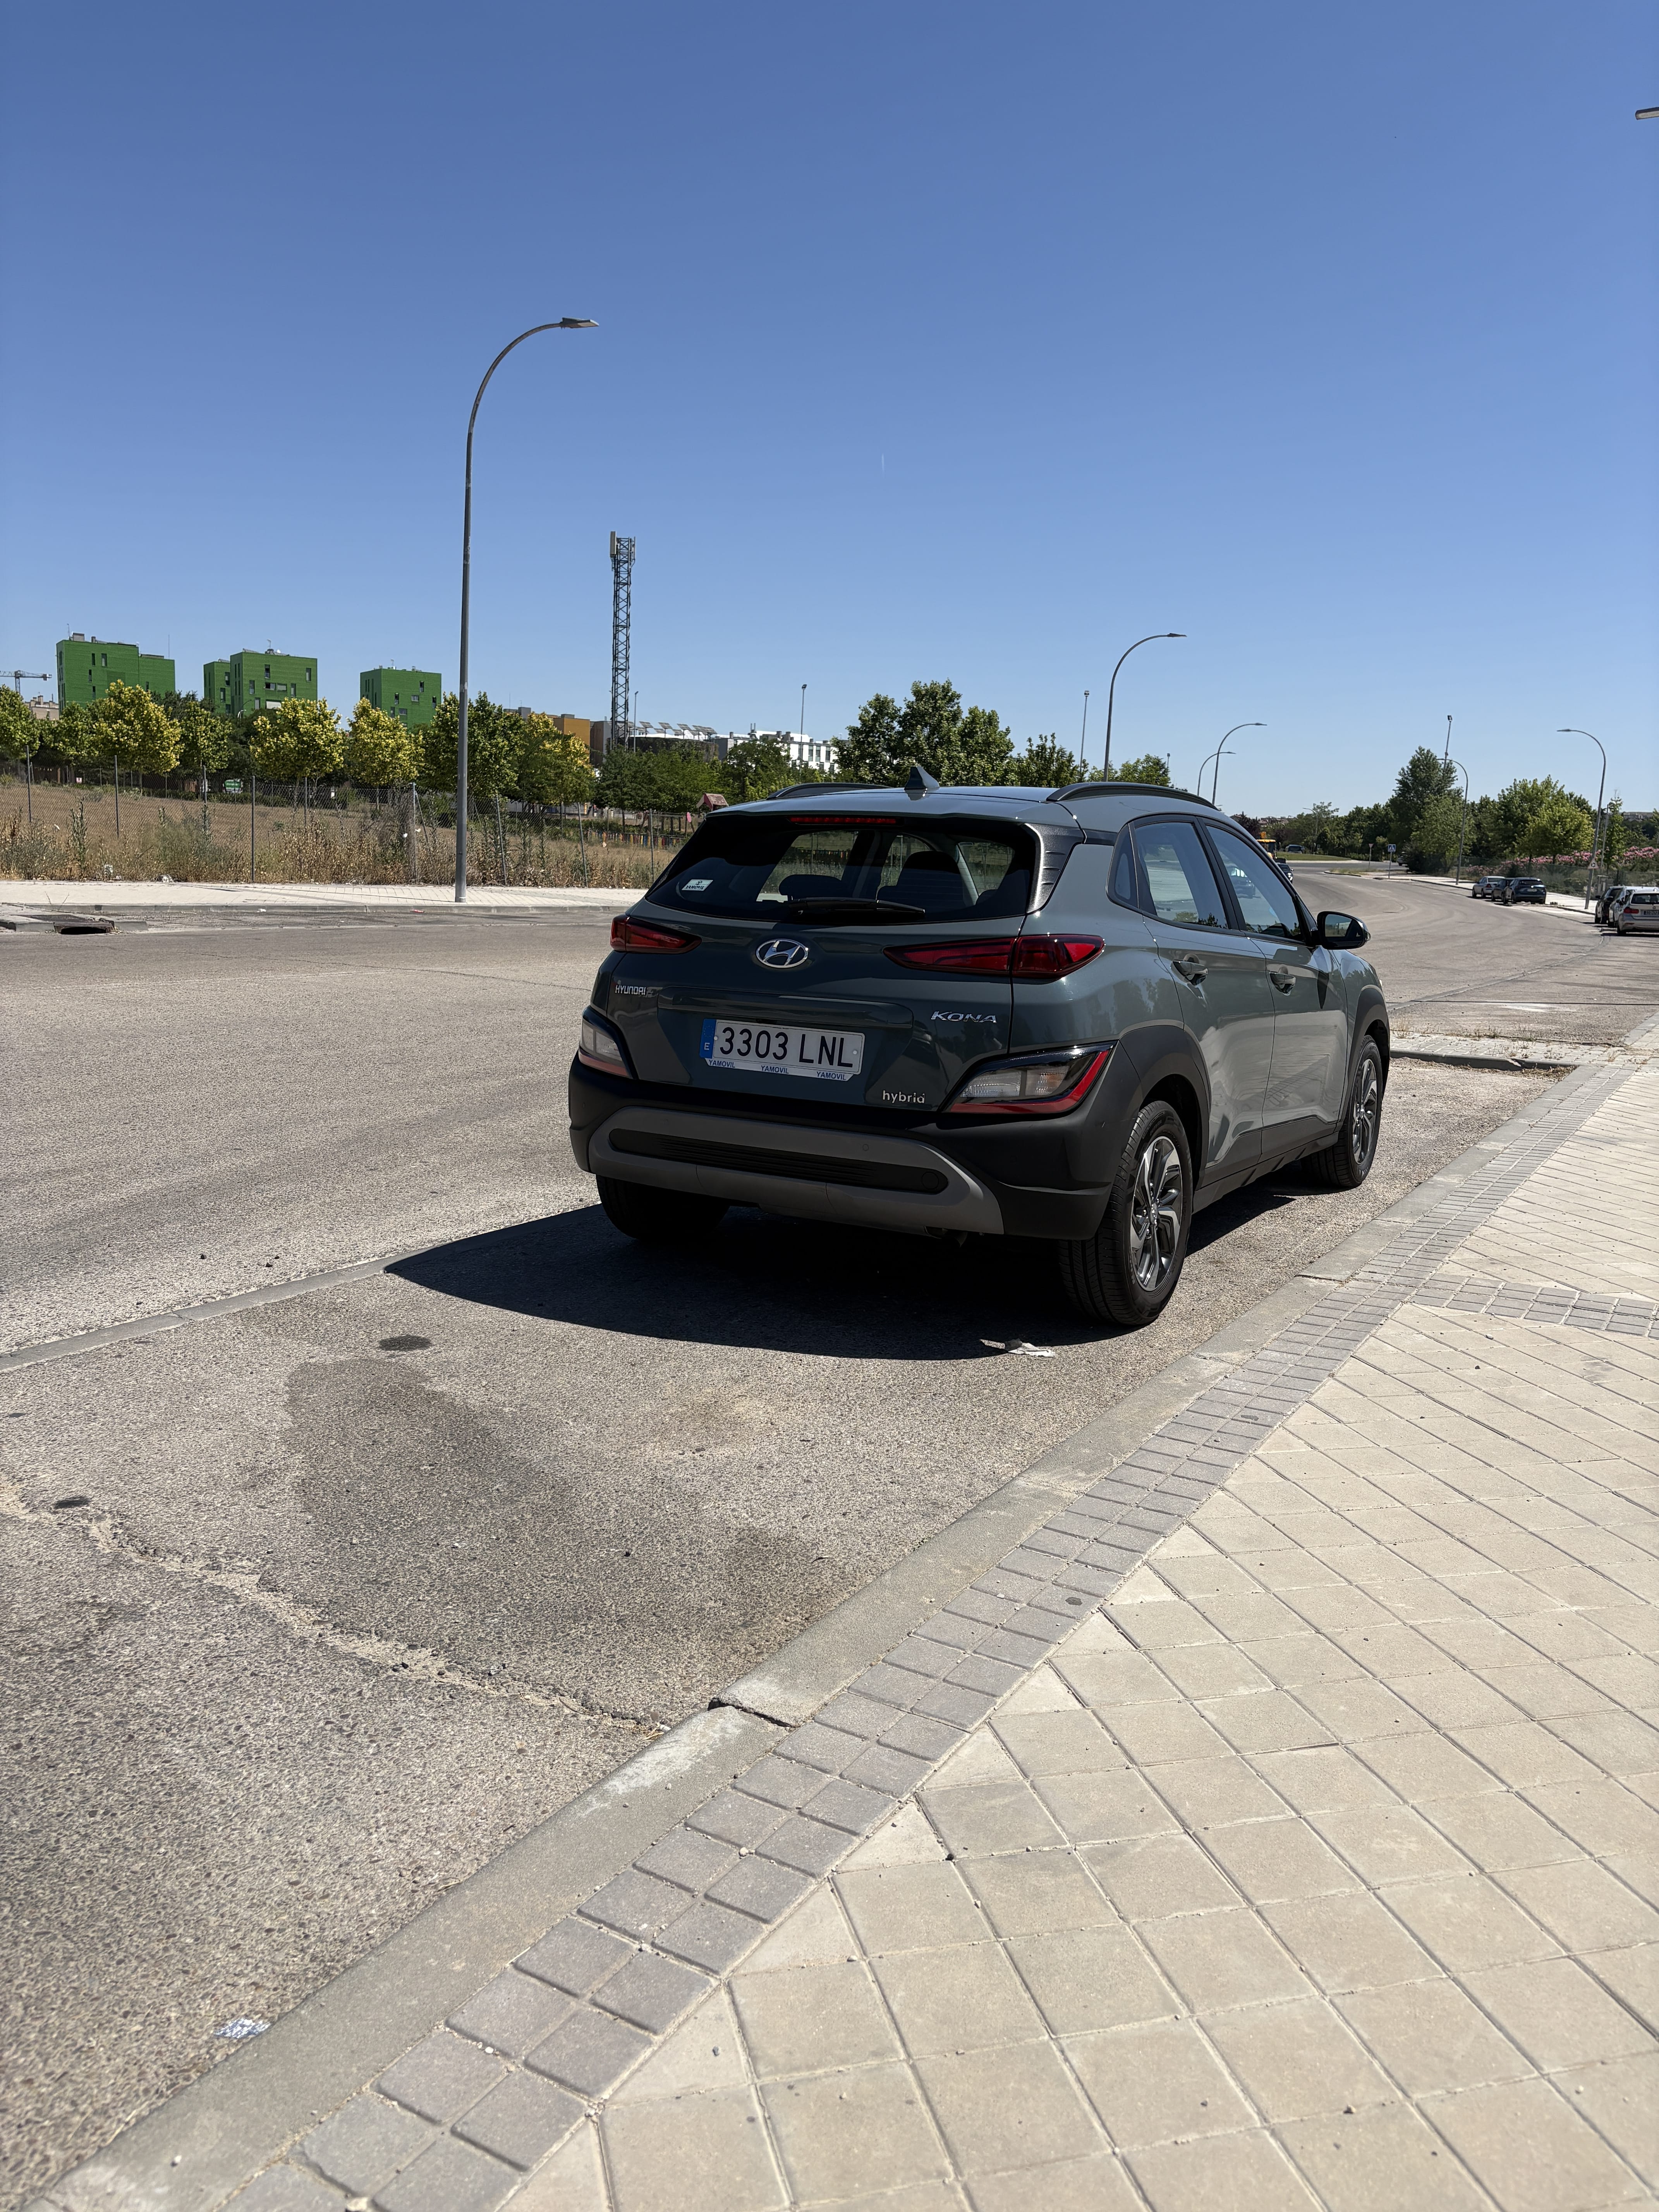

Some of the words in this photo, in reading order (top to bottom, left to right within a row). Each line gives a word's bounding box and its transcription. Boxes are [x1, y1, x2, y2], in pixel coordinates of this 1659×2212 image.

[615, 985, 646, 995] HYUNDAI
[931, 1011, 997, 1023] KONA
[720, 1027, 788, 1060] 3303
[799, 1034, 853, 1068] LNL
[709, 1060, 735, 1068] YAMOVIL
[761, 1065, 789, 1074] YAMOVIL
[816, 1072, 847, 1080] YAMOVIL
[883, 1090, 926, 1103] hybrid
